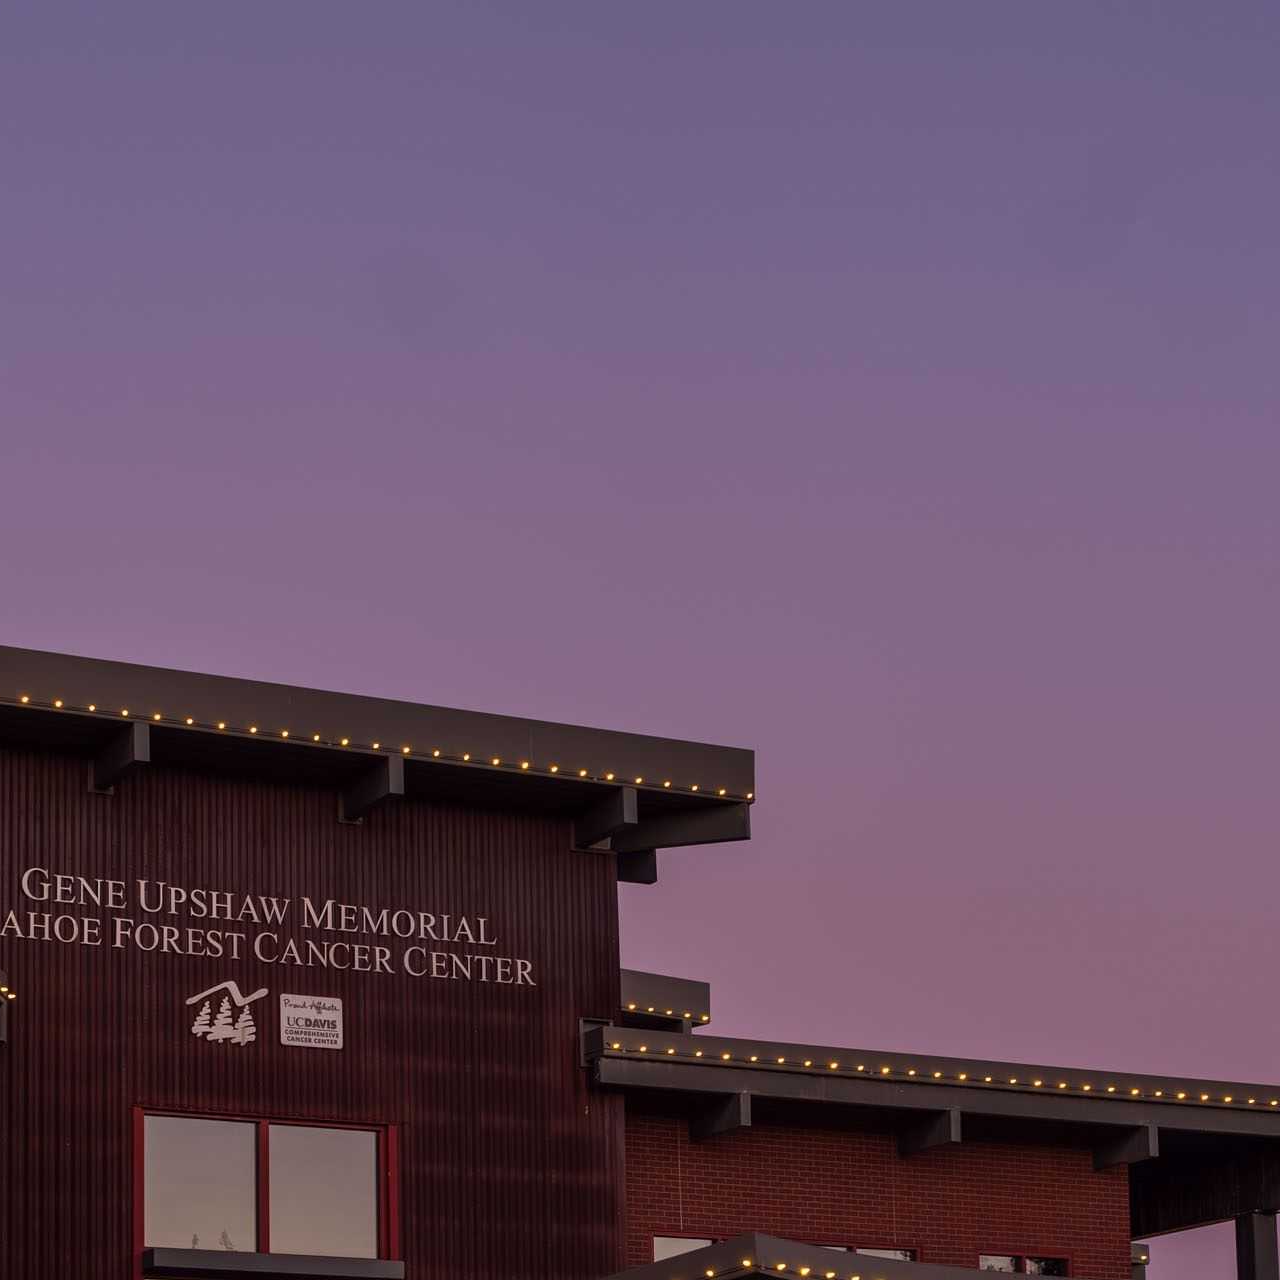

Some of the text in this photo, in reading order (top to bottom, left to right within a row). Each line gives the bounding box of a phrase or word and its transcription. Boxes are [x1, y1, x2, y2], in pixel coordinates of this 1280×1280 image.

[21, 867, 498, 945] GENE UPSHAW MEMORIAL
[111, 916, 246, 960] FOREST
[253, 932, 396, 974] CANCER
[403, 946, 537, 986] CENTER
[283, 998, 307, 1009] Proud
[284, 1029, 339, 1039] COMPREHENSIVE
